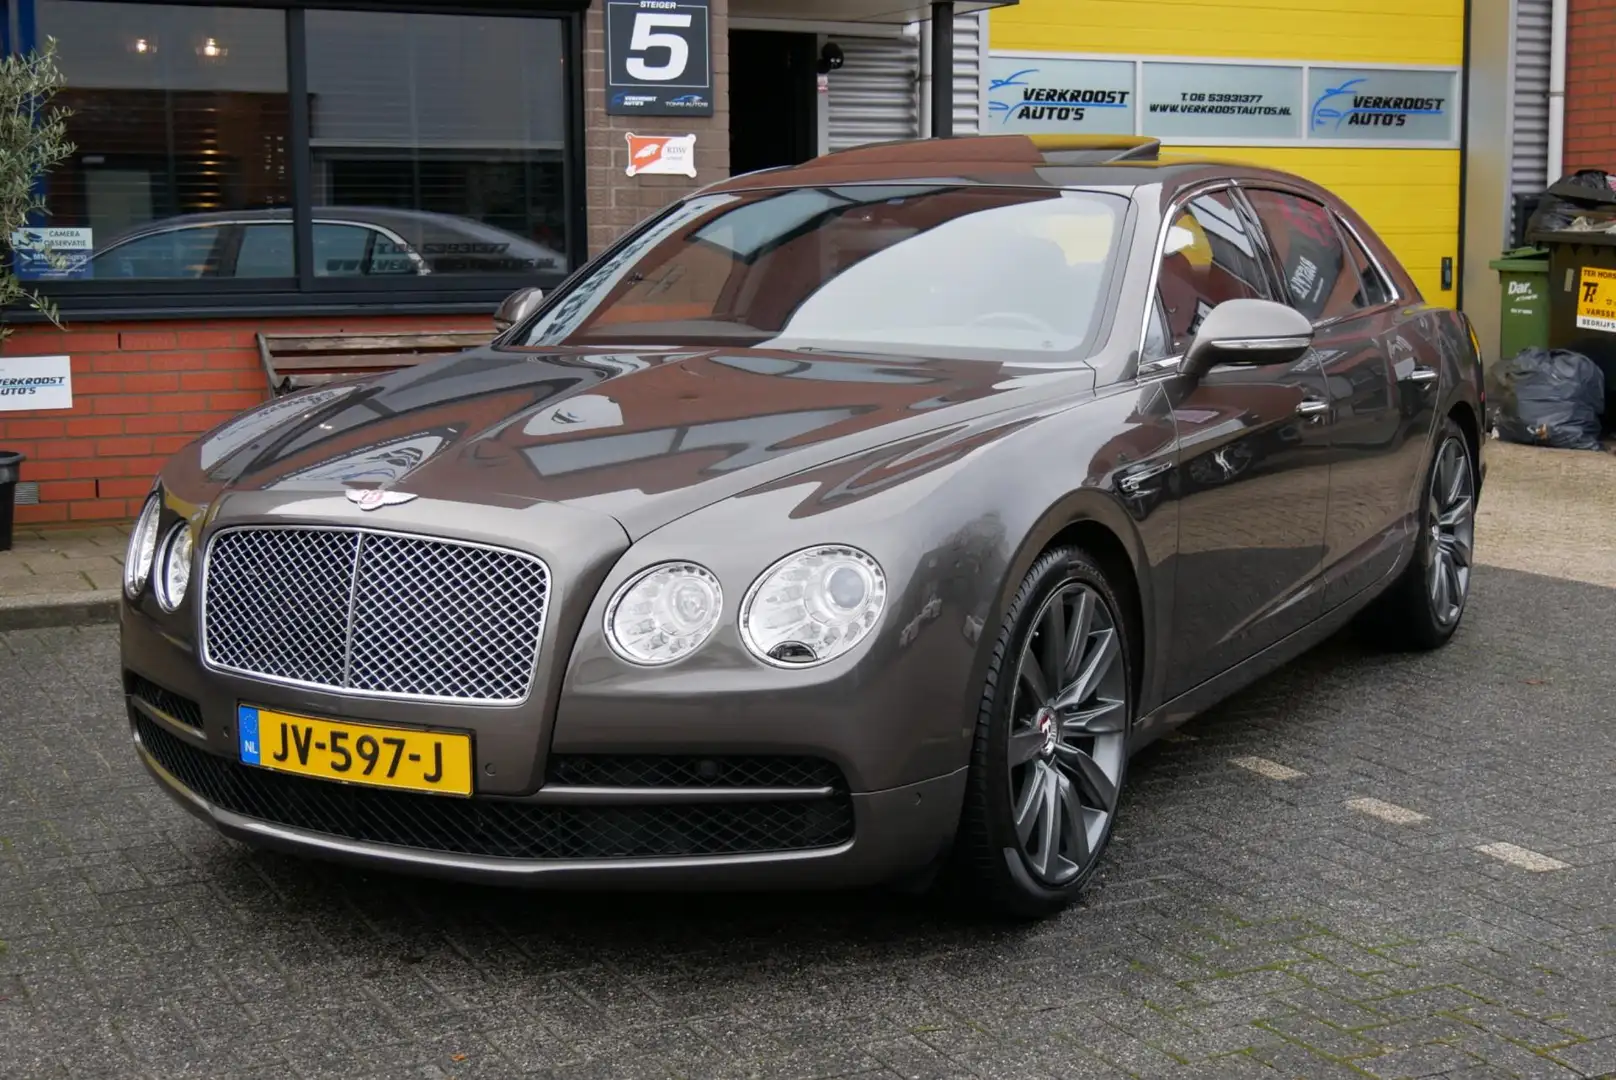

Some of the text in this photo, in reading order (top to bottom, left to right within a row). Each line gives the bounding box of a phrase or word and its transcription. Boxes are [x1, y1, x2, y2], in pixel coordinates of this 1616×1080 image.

[639, 1, 677, 9] STEIGER
[626, 12, 692, 81] 5
[1023, 87, 1130, 104] VERKROOST
[1190, 93, 1206, 102] 06
[1208, 93, 1264, 104] 53931377
[1149, 103, 1293, 116] WWW.VERKROOSTAUTOS.NL
[1353, 95, 1445, 111] VERKROOST
[1017, 106, 1086, 121] AUTO'S
[1347, 112, 1407, 127] AUTO'S
[48, 230, 81, 238] CAMERA
[43, 239, 87, 247] OBSERVATIE
[244, 740, 258, 754] NL
[273, 722, 443, 783] JV-597-J
